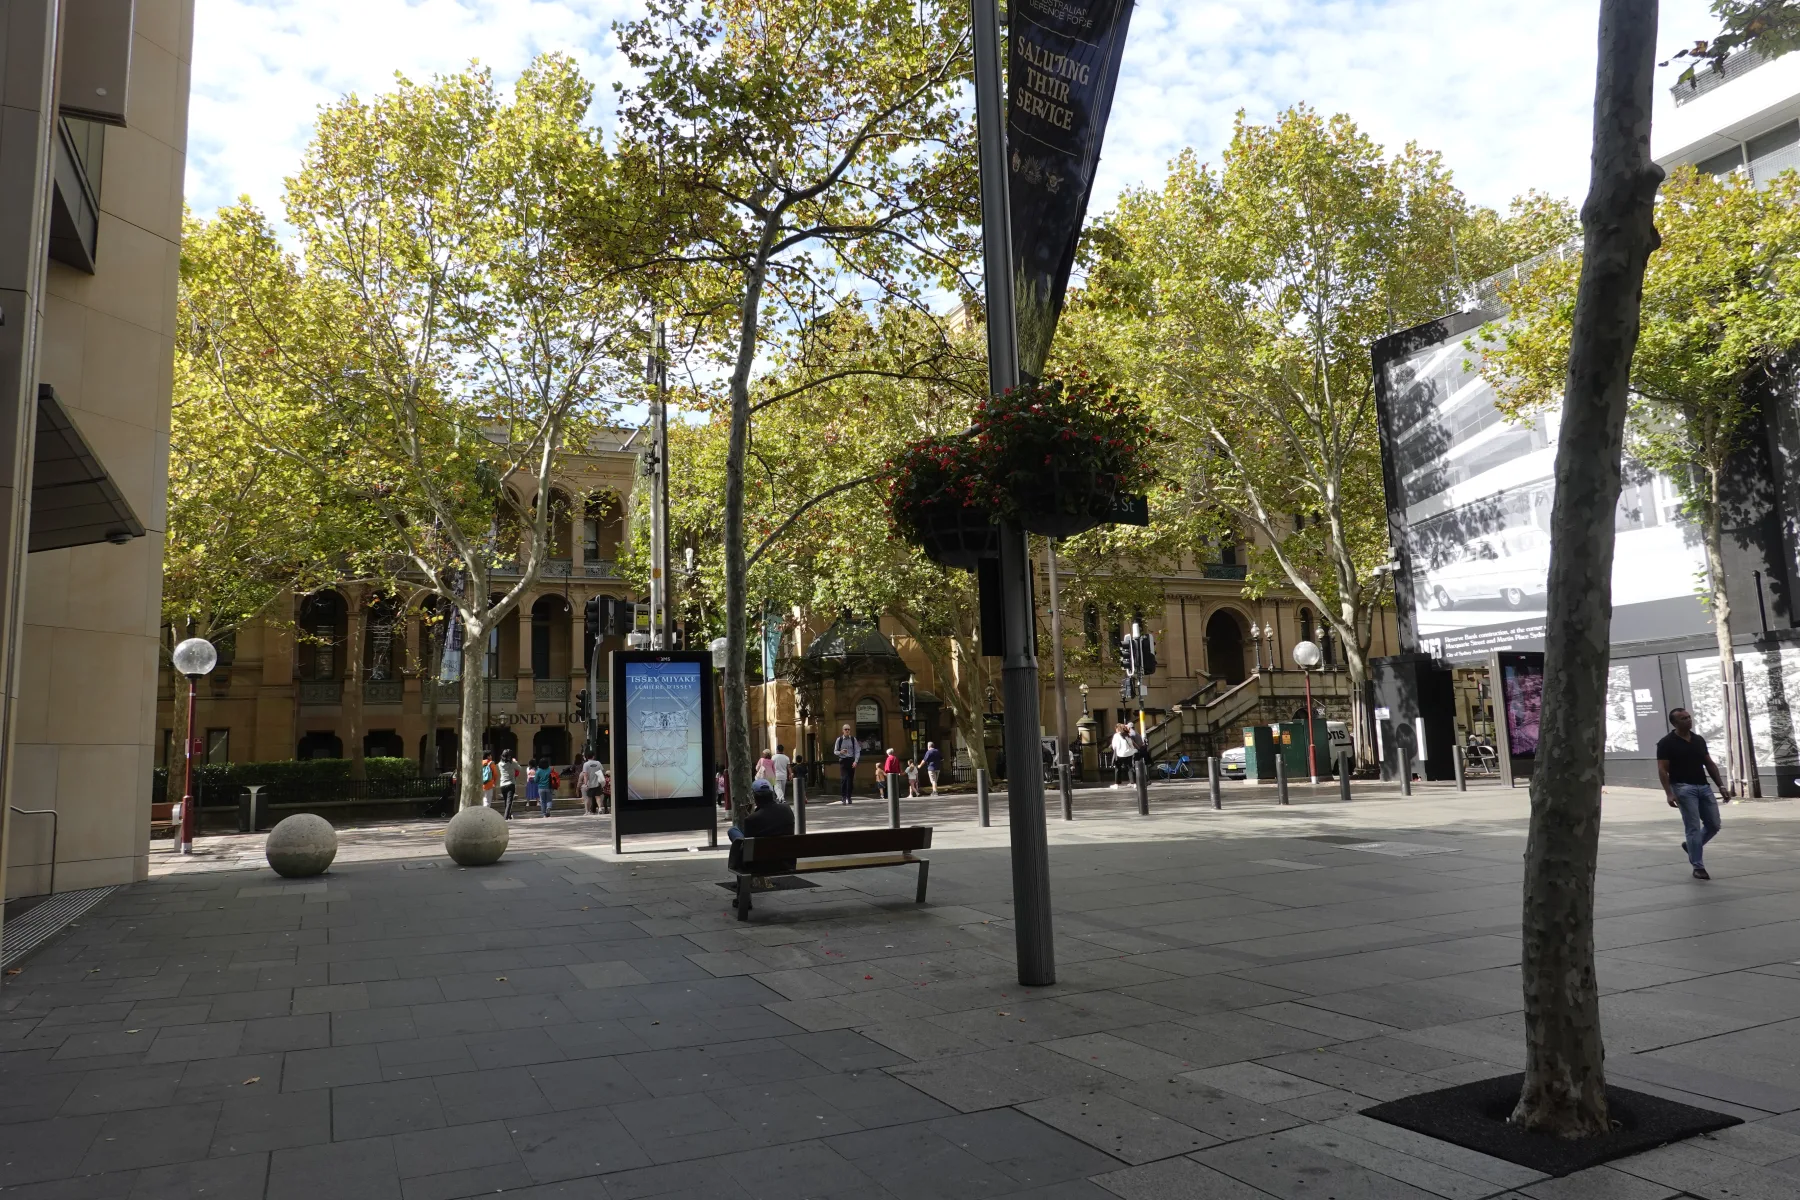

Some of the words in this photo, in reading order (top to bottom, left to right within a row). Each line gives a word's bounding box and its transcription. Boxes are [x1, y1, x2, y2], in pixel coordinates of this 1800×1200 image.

[1029, 0, 1065, 20] DEFENCE
[1042, 0, 1089, 16] STRALIAN
[1017, 35, 1090, 85] SALUTING
[1016, 86, 1074, 130] SERVICE
[1121, 498, 1135, 512] St
[1445, 641, 1470, 649] Macquarie
[1529, 631, 1546, 639] Sydn
[490, 713, 549, 725] SDNEY
